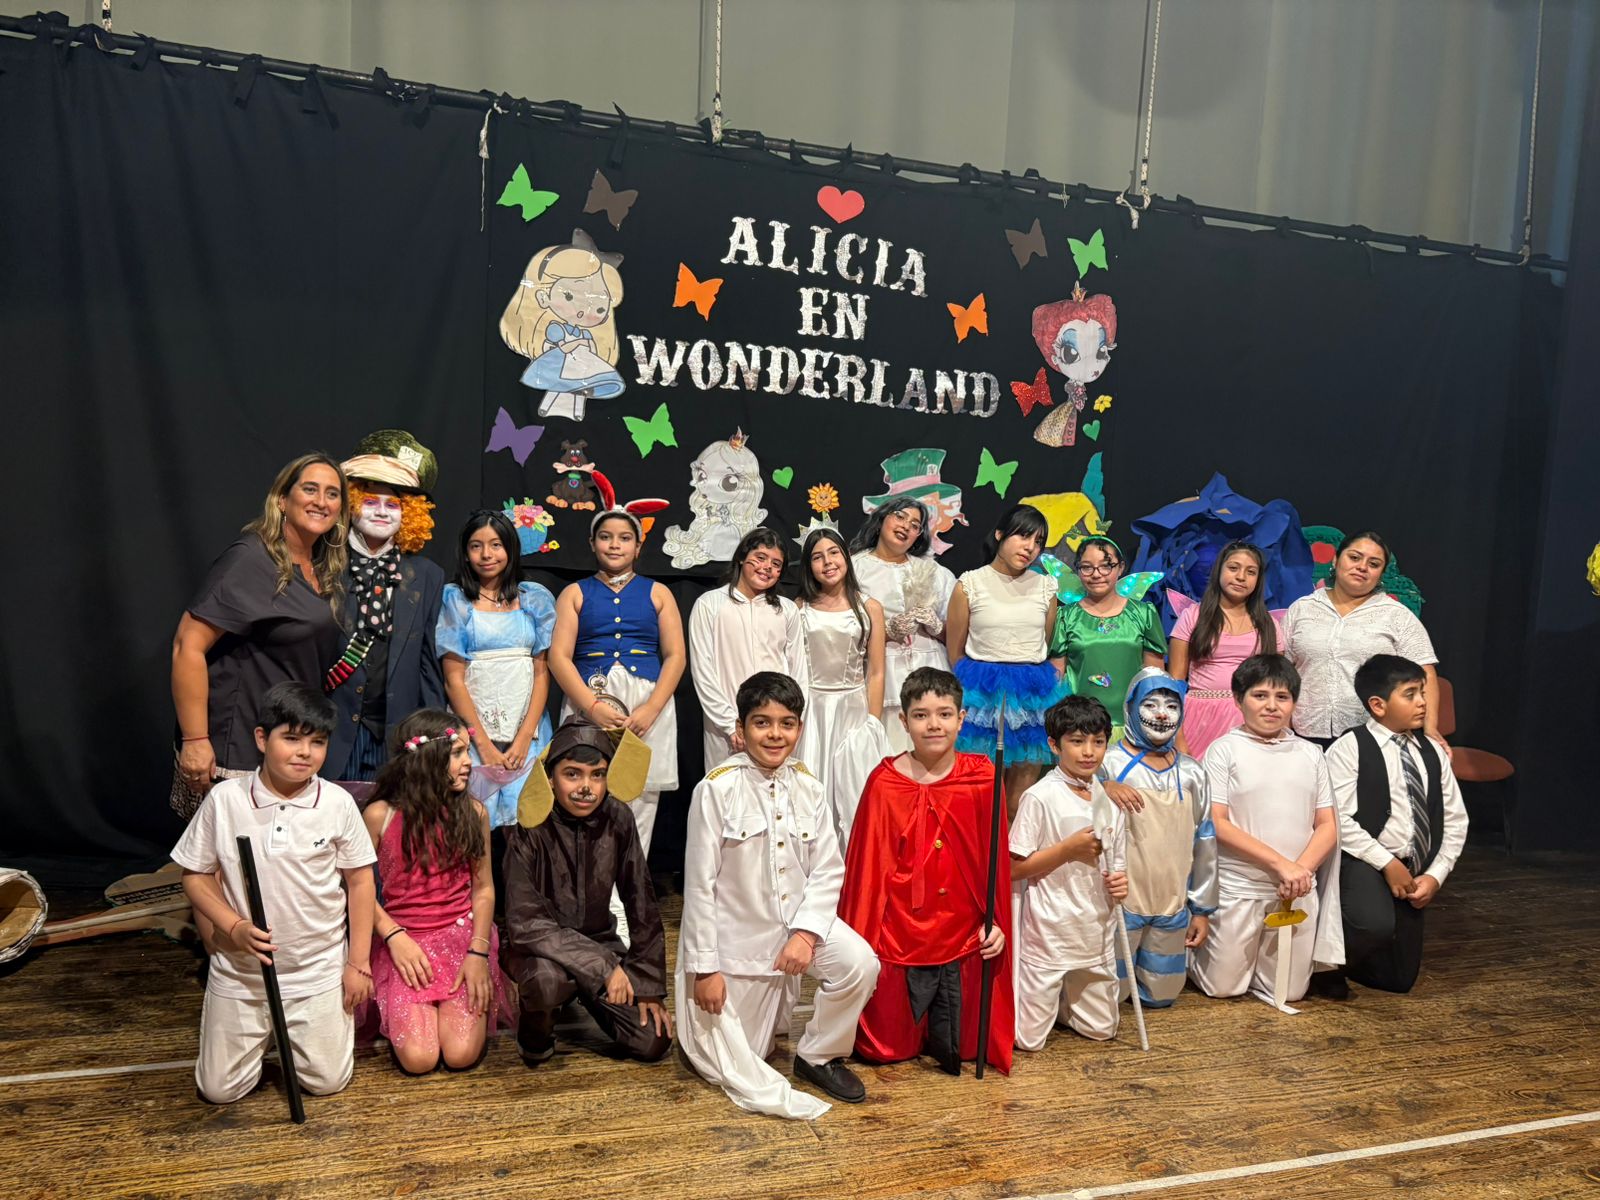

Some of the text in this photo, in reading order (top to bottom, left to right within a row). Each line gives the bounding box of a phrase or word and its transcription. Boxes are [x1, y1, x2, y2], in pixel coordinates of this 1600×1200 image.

[720, 215, 929, 298] ALICIA
[797, 286, 870, 341] EN
[625, 334, 1002, 419] WONDERLAND
